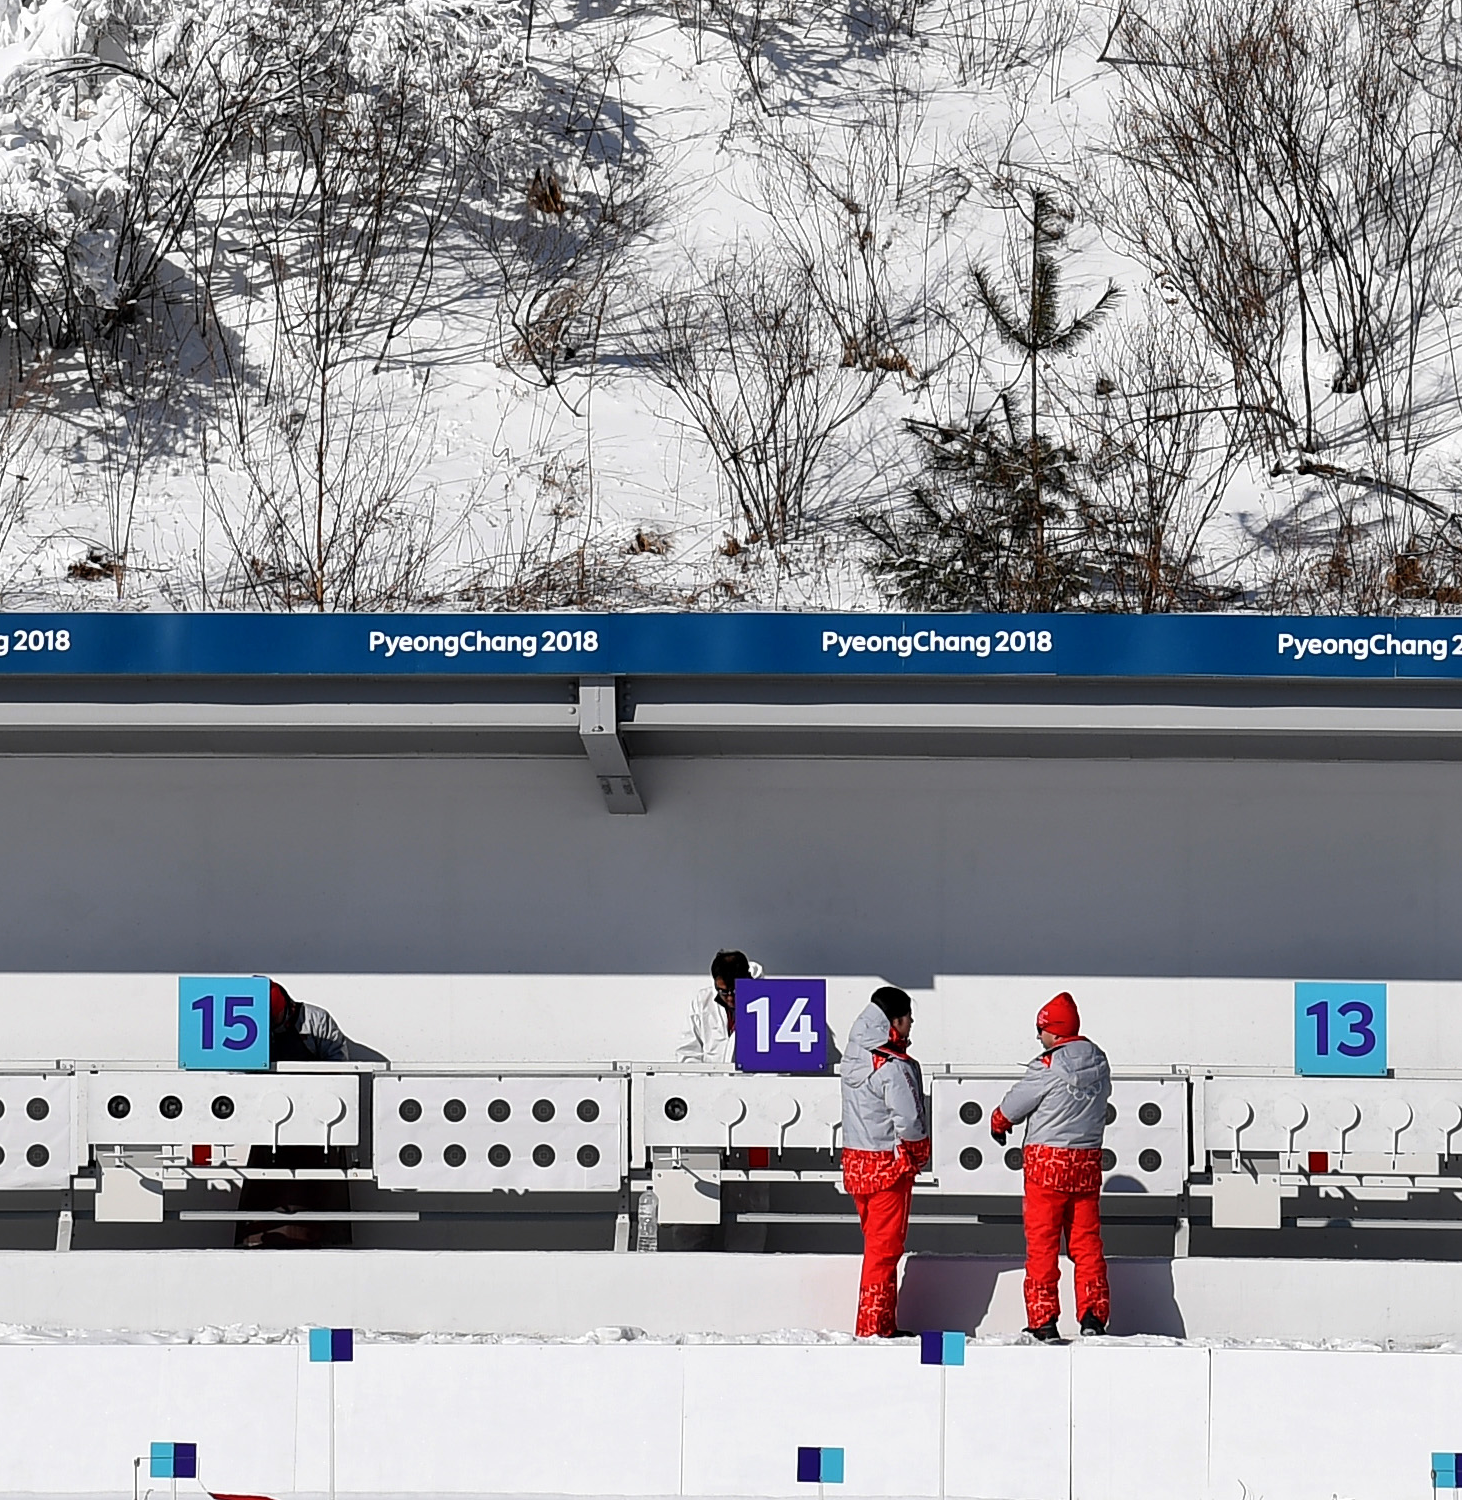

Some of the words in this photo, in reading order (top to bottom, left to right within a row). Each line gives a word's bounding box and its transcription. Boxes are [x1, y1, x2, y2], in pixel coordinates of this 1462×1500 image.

[14, 630, 70, 650] 2018
[370, 631, 536, 657] PyeongChang
[542, 631, 598, 651] 2018
[823, 631, 990, 657] PyeongChang
[995, 631, 1052, 651] 2018
[1279, 634, 1447, 660] PyeongChang
[192, 996, 258, 1050] 15
[746, 996, 819, 1053] 14
[1306, 1001, 1376, 1056] 13
